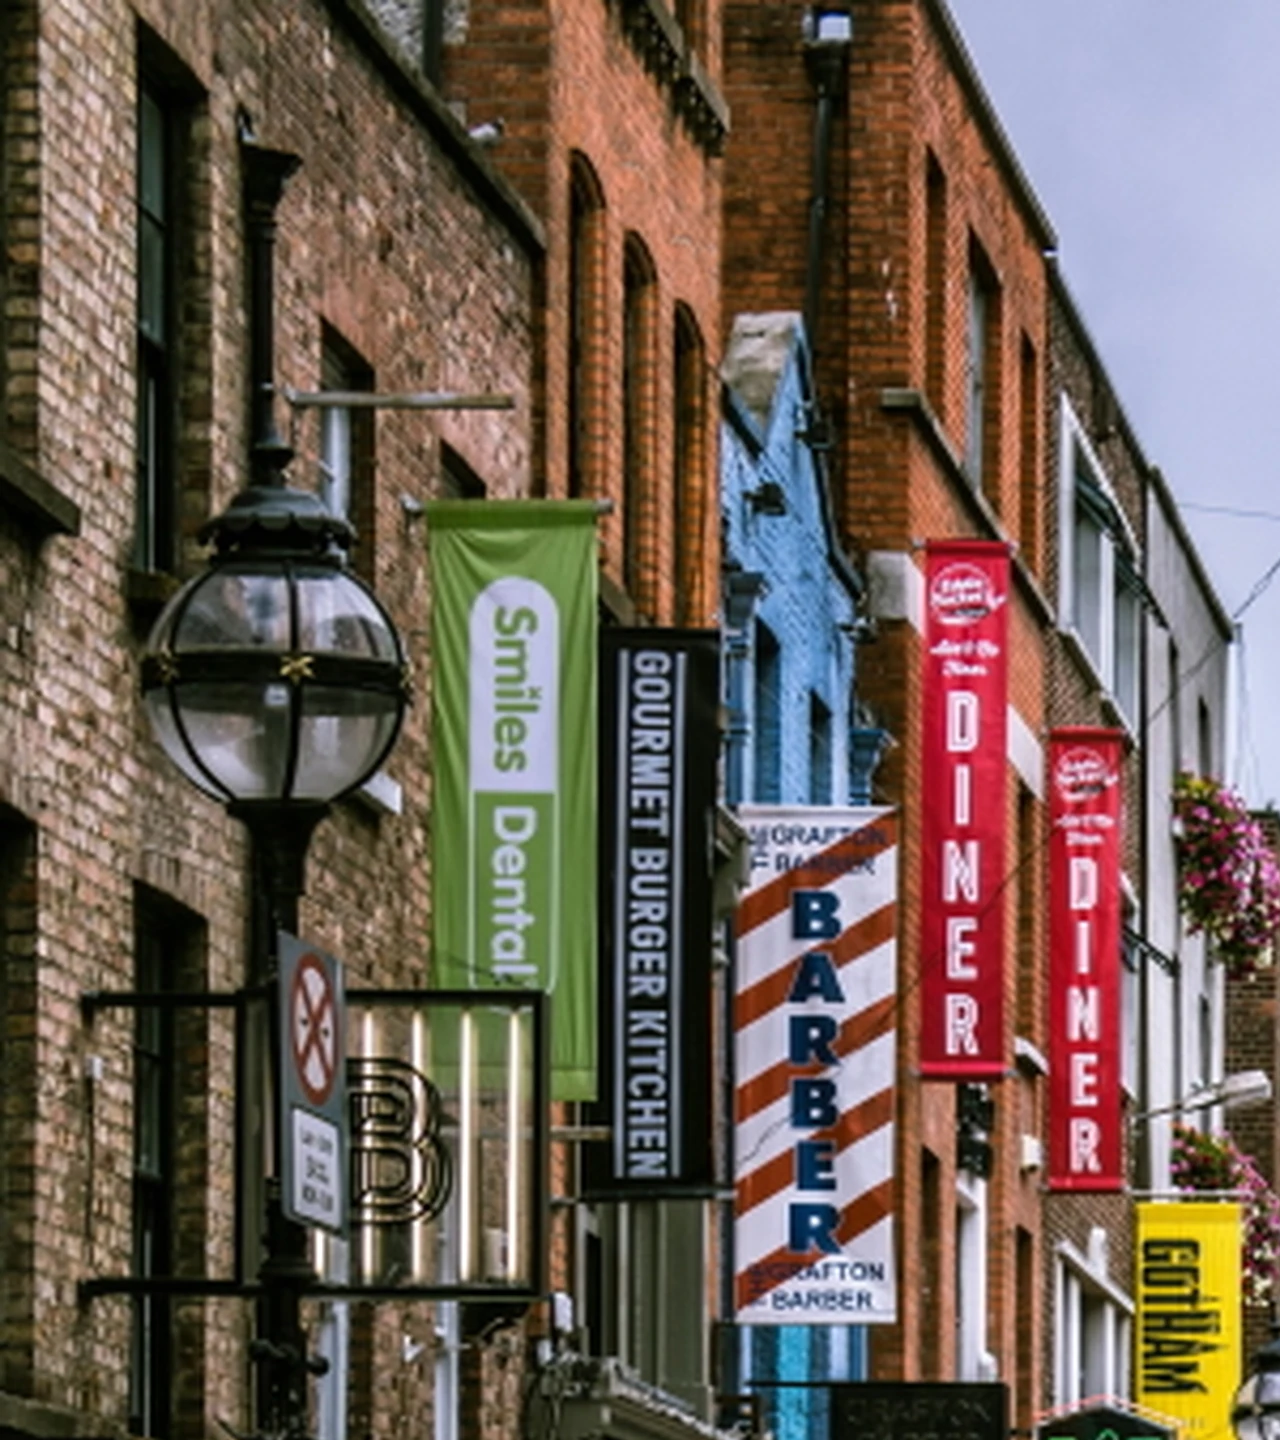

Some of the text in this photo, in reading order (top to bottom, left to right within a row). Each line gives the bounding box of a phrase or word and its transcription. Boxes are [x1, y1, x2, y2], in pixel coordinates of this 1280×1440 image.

[492, 606, 540, 773] Smiles
[490, 806, 537, 980] Dental
[627, 651, 671, 1179] GOURMET BURGER KITCHEN
[944, 690, 981, 1056] DINER
[789, 890, 844, 1254] BARBER
[1068, 857, 1102, 1174] DINER
[772, 1289, 873, 1311] BARBER
[1142, 1238, 1230, 1394] GOTHAM
